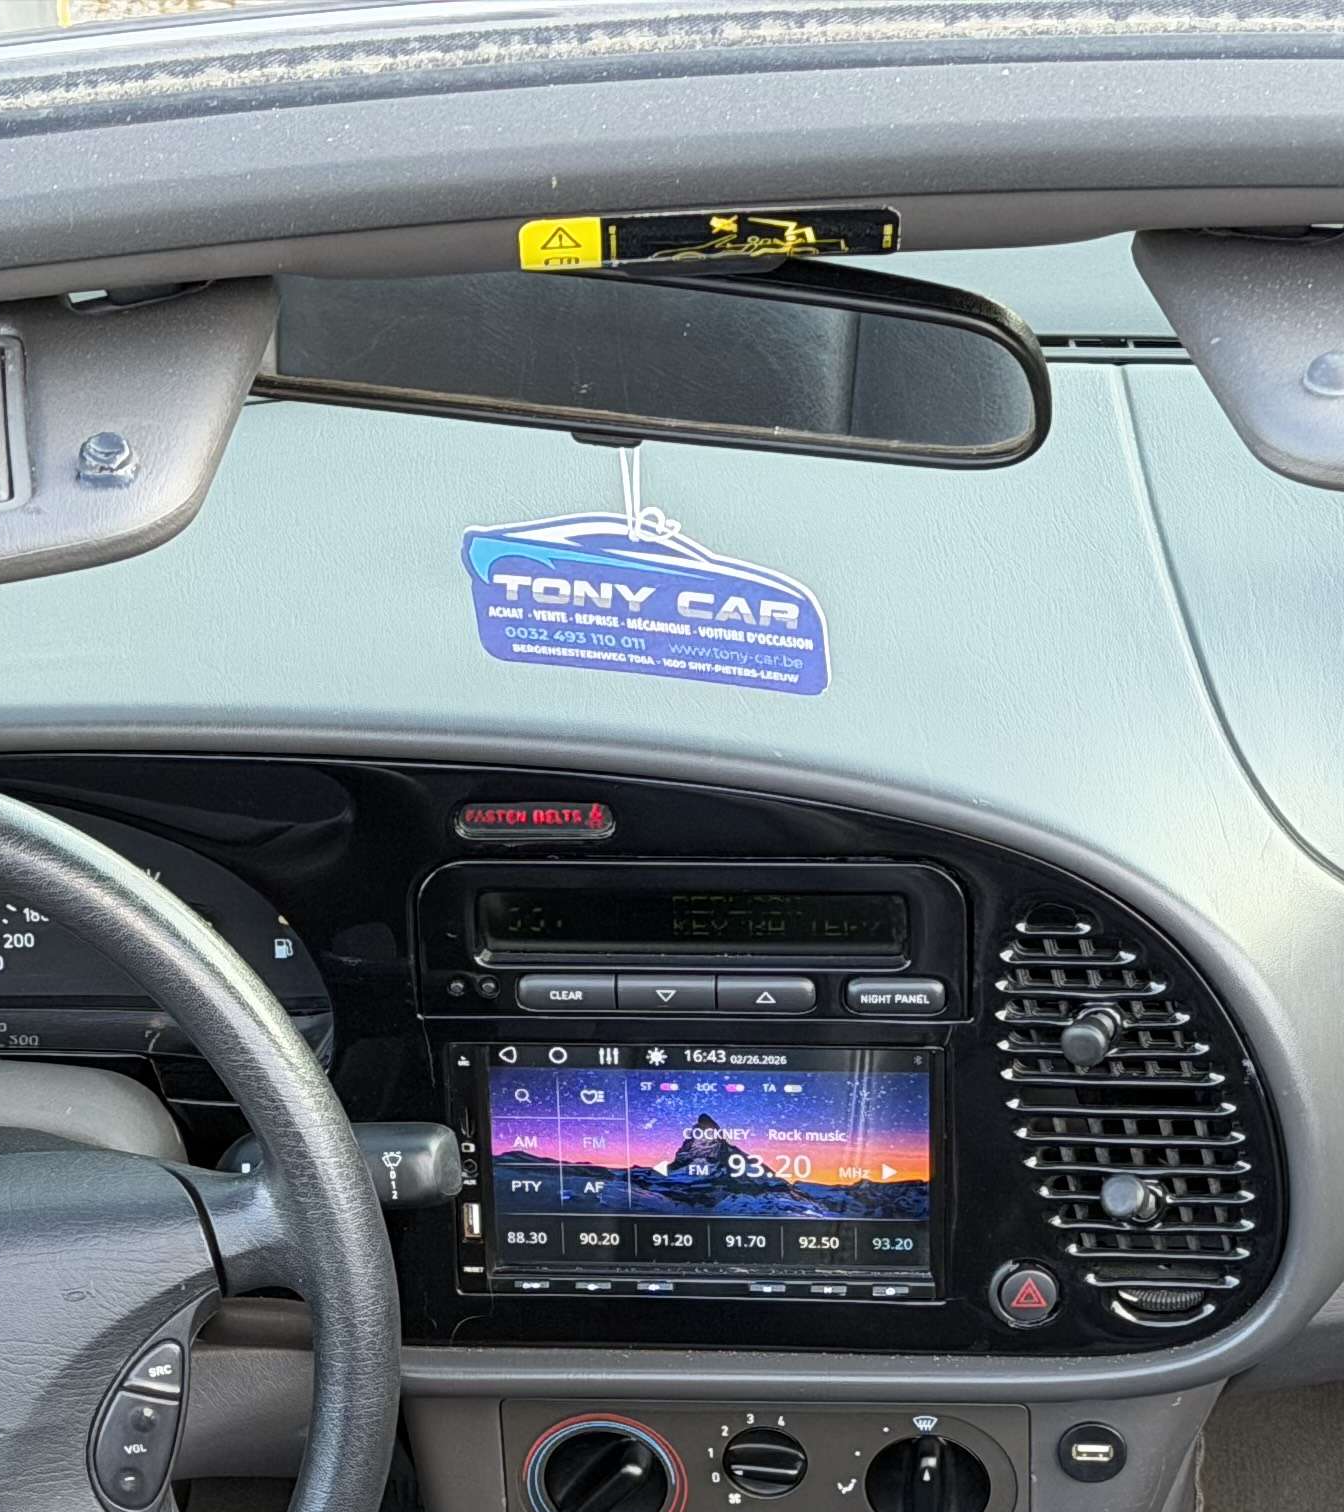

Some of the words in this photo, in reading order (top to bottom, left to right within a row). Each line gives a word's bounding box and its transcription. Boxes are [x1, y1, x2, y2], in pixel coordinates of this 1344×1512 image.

[493, 573, 656, 613] TONY
[677, 591, 800, 629] CAR
[533, 609, 568, 623] VENTE
[575, 613, 619, 628] REPRISE
[698, 626, 745, 642] VOITURE
[505, 626, 549, 641] 0032
[553, 630, 587, 644] 493
[590, 633, 616, 647] 110
[621, 636, 646, 650] 011
[668, 641, 804, 669] www.tony-car.be
[3, 933, 35, 949] 200
[549, 990, 582, 1001] CLEAR
[860, 994, 891, 1005] NIGHT
[894, 994, 930, 1006] PANEL
[684, 1050, 726, 1063] 16:43
[640, 1082, 652, 1091] ST
[762, 1083, 776, 1092] TA
[768, 1128, 802, 1141] Rock
[805, 1128, 847, 1142] music
[513, 1136, 537, 1148] AM
[583, 1137, 605, 1149] FM
[689, 1165, 709, 1176] FM
[728, 1154, 811, 1178] 93.20
[839, 1167, 870, 1179] MHz
[511, 1181, 542, 1192] PTY
[584, 1182, 605, 1193] AF
[507, 1232, 547, 1244] 88.30
[579, 1233, 620, 1245] 90.20
[652, 1234, 693, 1247] 91.20
[725, 1235, 766, 1248] 91.70
[798, 1236, 840, 1249] 92.50
[872, 1238, 913, 1250] 93.20
[148, 1364, 172, 1378] SRC
[746, 1413, 755, 1424] 3
[777, 1415, 786, 1427] 4
[721, 1425, 729, 1437] 2
[123, 1444, 147, 1455] VOL
[707, 1447, 714, 1459] 1
[711, 1472, 721, 1483] 0
